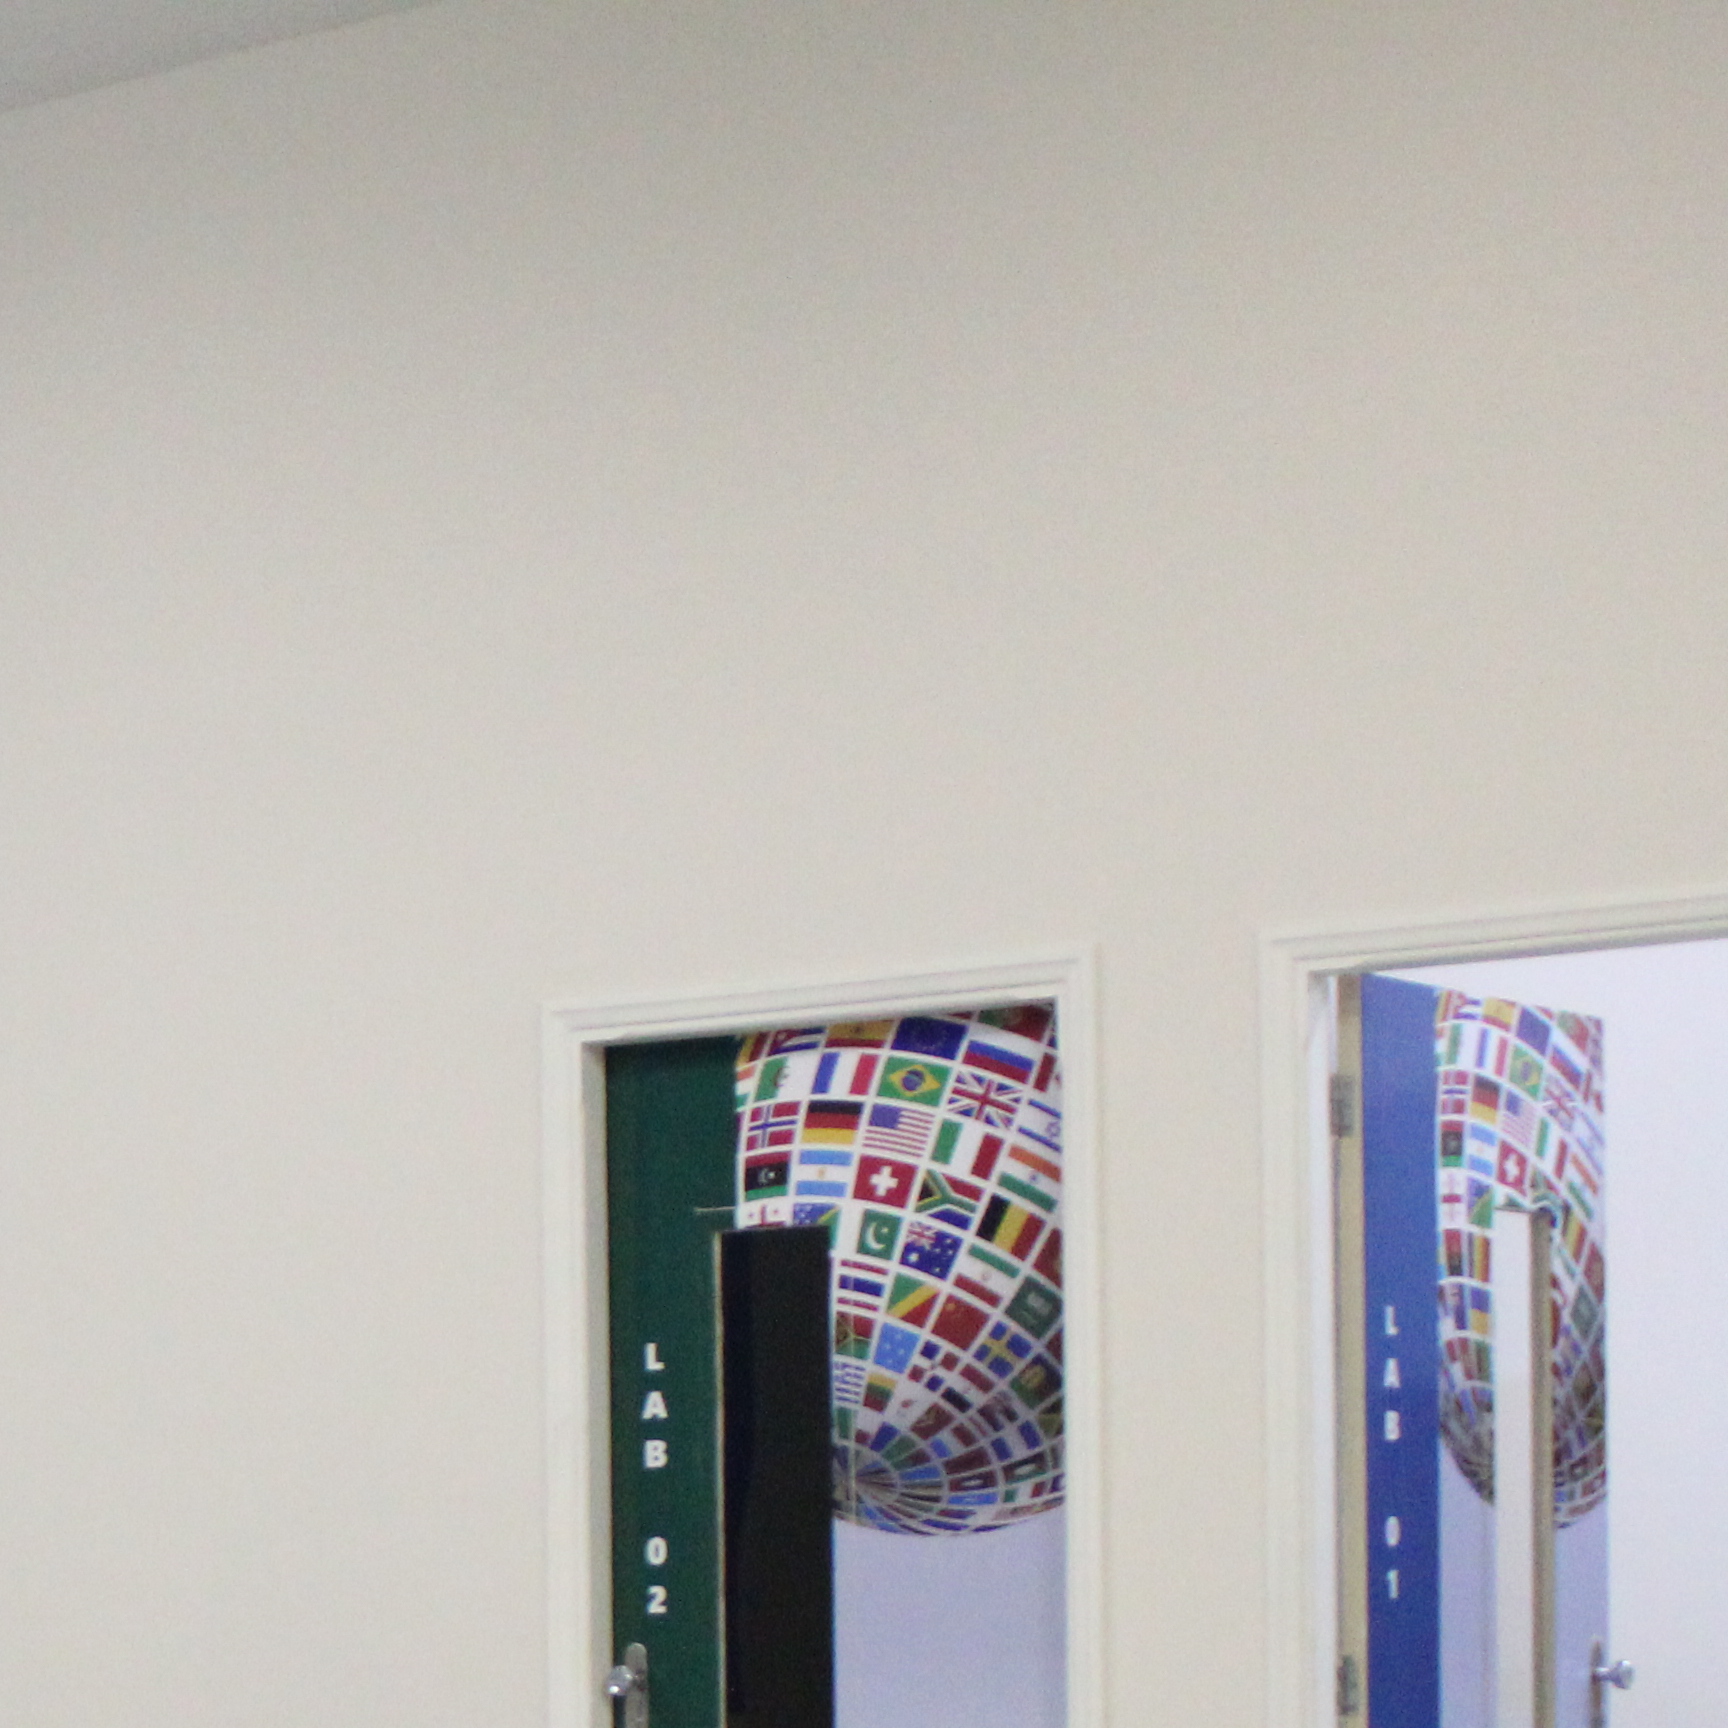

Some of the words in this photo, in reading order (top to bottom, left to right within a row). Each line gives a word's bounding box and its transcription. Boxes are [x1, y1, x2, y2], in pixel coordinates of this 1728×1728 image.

[642, 1342, 669, 1469] LAB
[1382, 1304, 1401, 1441] LAB
[645, 1535, 668, 1615] 02
[1385, 1515, 1401, 1600] 01
